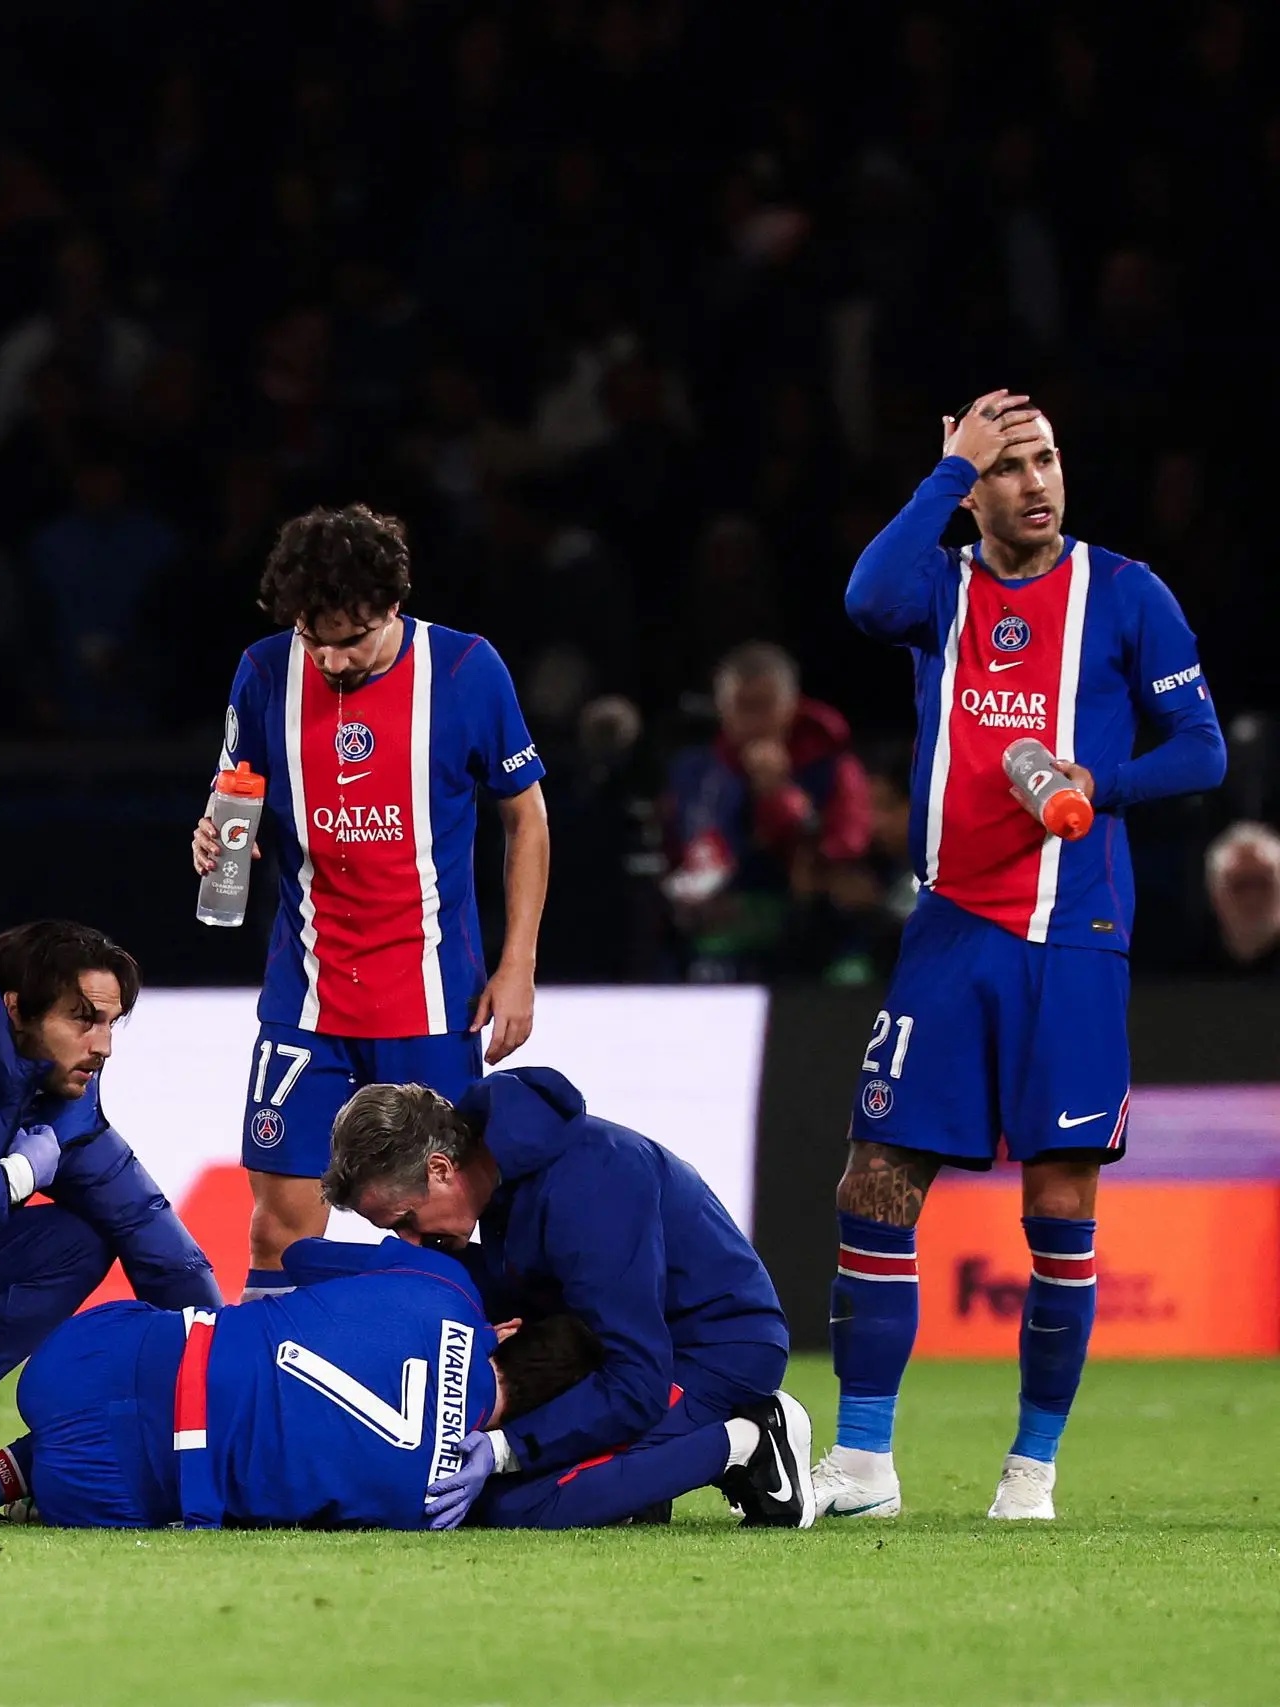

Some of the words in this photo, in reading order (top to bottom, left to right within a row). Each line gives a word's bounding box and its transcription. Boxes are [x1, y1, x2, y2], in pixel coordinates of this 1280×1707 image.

[961, 688, 1047, 716] QATAR
[341, 724, 368, 736] PARIS
[978, 713, 1046, 731] AIRWAYS
[313, 805, 403, 833] QATAR
[221, 818, 251, 850] G
[335, 827, 404, 843] AIRWAYS
[861, 1009, 914, 1079] 21
[253, 1039, 312, 1107] 17
[257, 1110, 280, 1121] PARIS
[276, 1340, 428, 1451] 7
